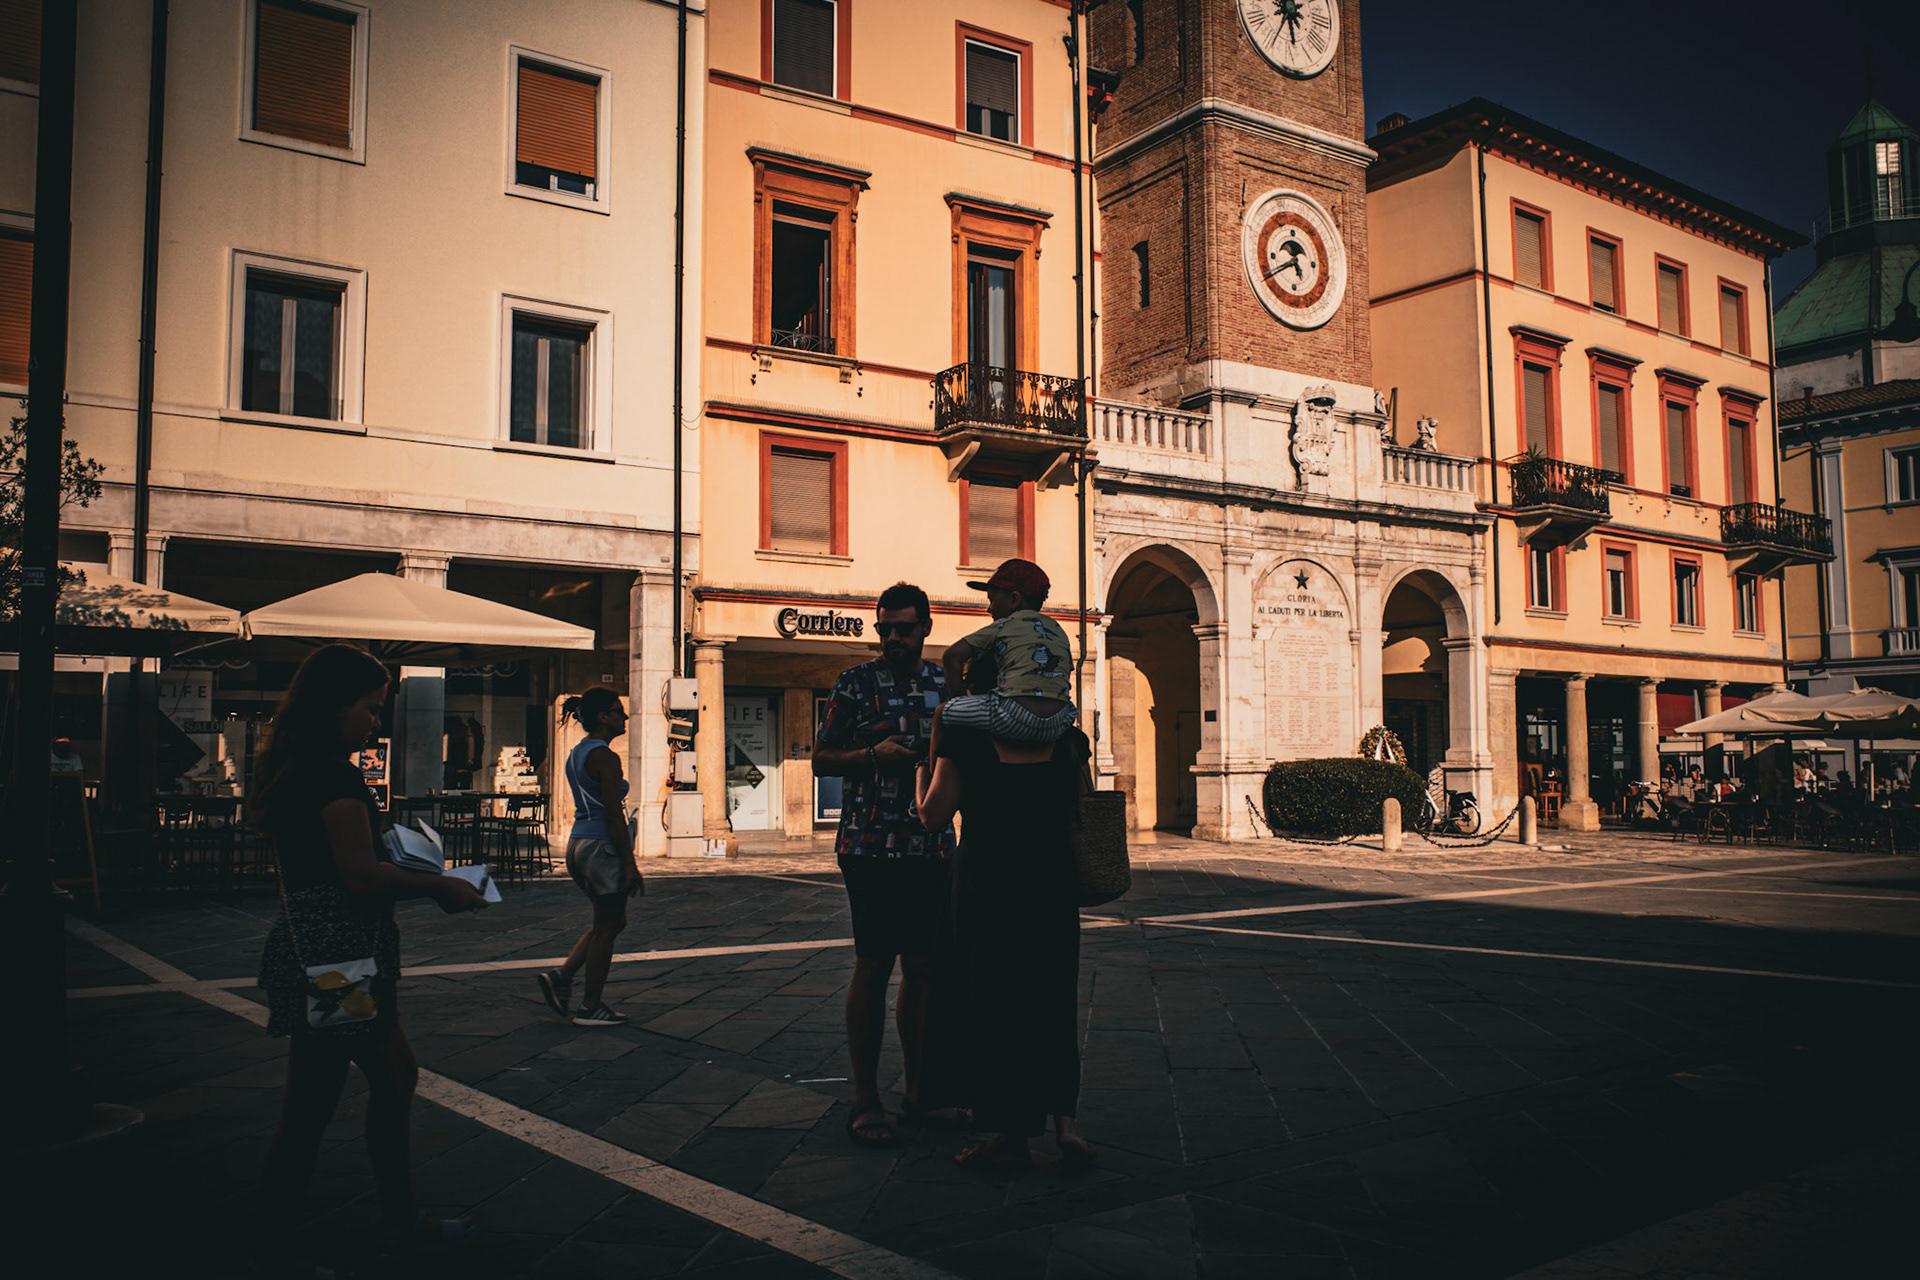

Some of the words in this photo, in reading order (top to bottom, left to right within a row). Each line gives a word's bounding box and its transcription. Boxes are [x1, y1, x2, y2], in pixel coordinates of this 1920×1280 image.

[1287, 594, 1316, 604] GLORIA
[1257, 606, 1265, 614] AI
[1268, 606, 1291, 615] CADUTI
[1294, 608, 1305, 616] PER
[1308, 609, 1317, 617] LA
[777, 607, 864, 634] Corriere
[159, 685, 207, 698] LIFE
[733, 707, 763, 720] IFE
[186, 721, 223, 732] SALDI
